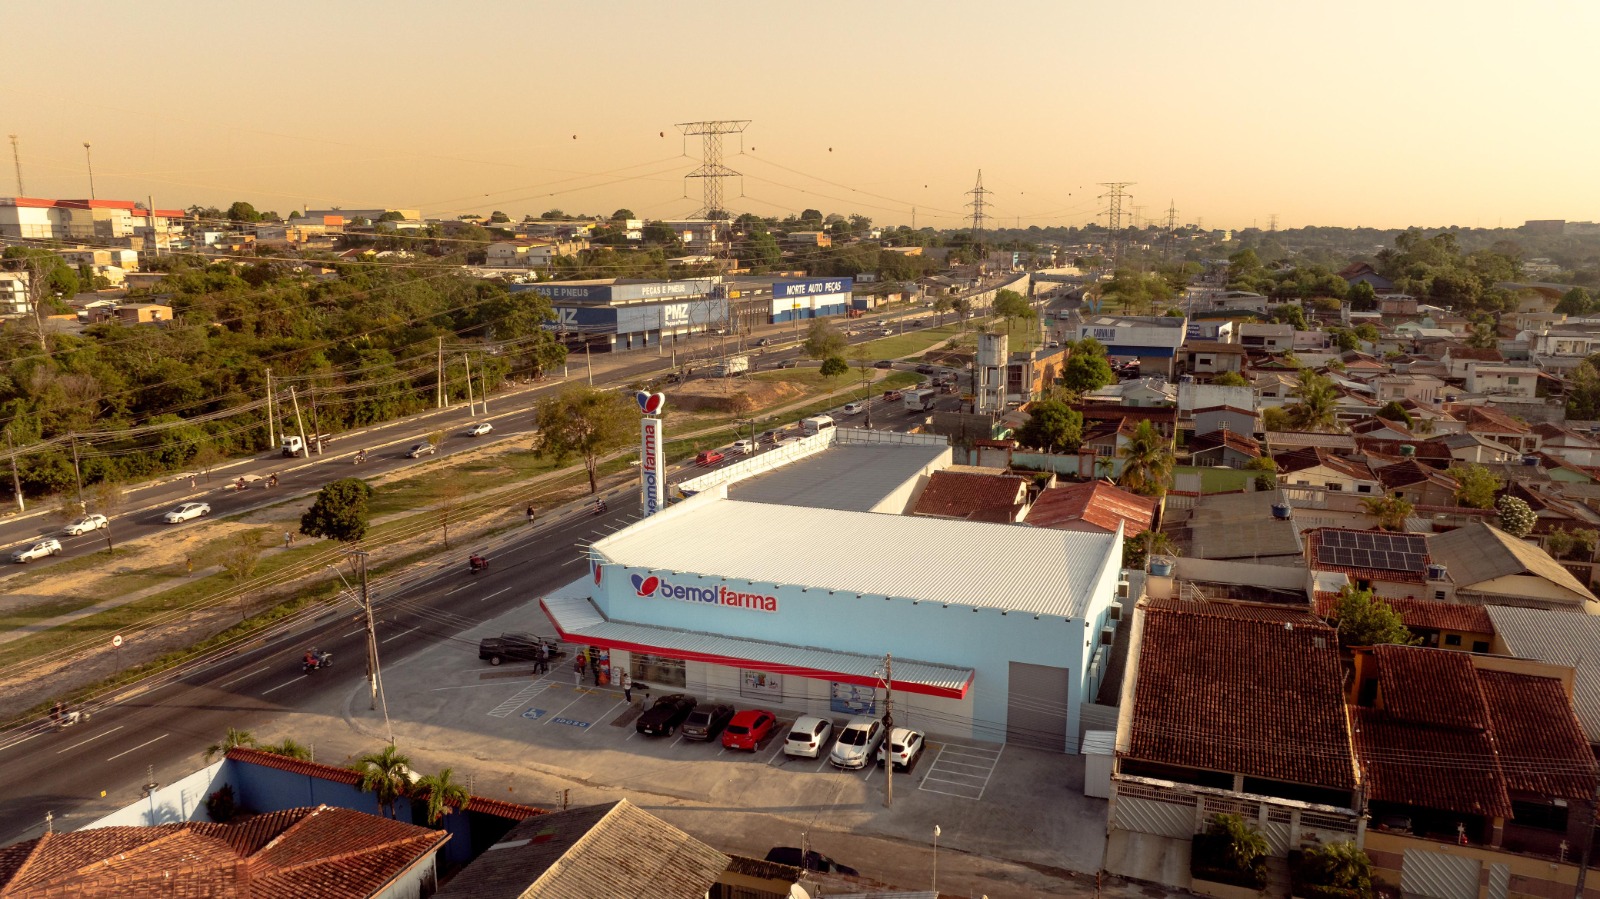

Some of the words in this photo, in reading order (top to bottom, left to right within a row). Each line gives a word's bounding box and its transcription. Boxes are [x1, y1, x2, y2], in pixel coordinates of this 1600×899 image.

[561, 289, 588, 297] PNEUS
[642, 286, 660, 296] PEÇAS
[662, 286, 666, 294] E
[668, 285, 685, 293] PNEUS
[787, 284, 805, 295] NORTE
[808, 283, 822, 293] AUTO
[825, 282, 841, 293] PEÇAS
[551, 307, 578, 323] MZ
[665, 303, 689, 320] PMZ
[660, 579, 777, 612] bemolfarma
